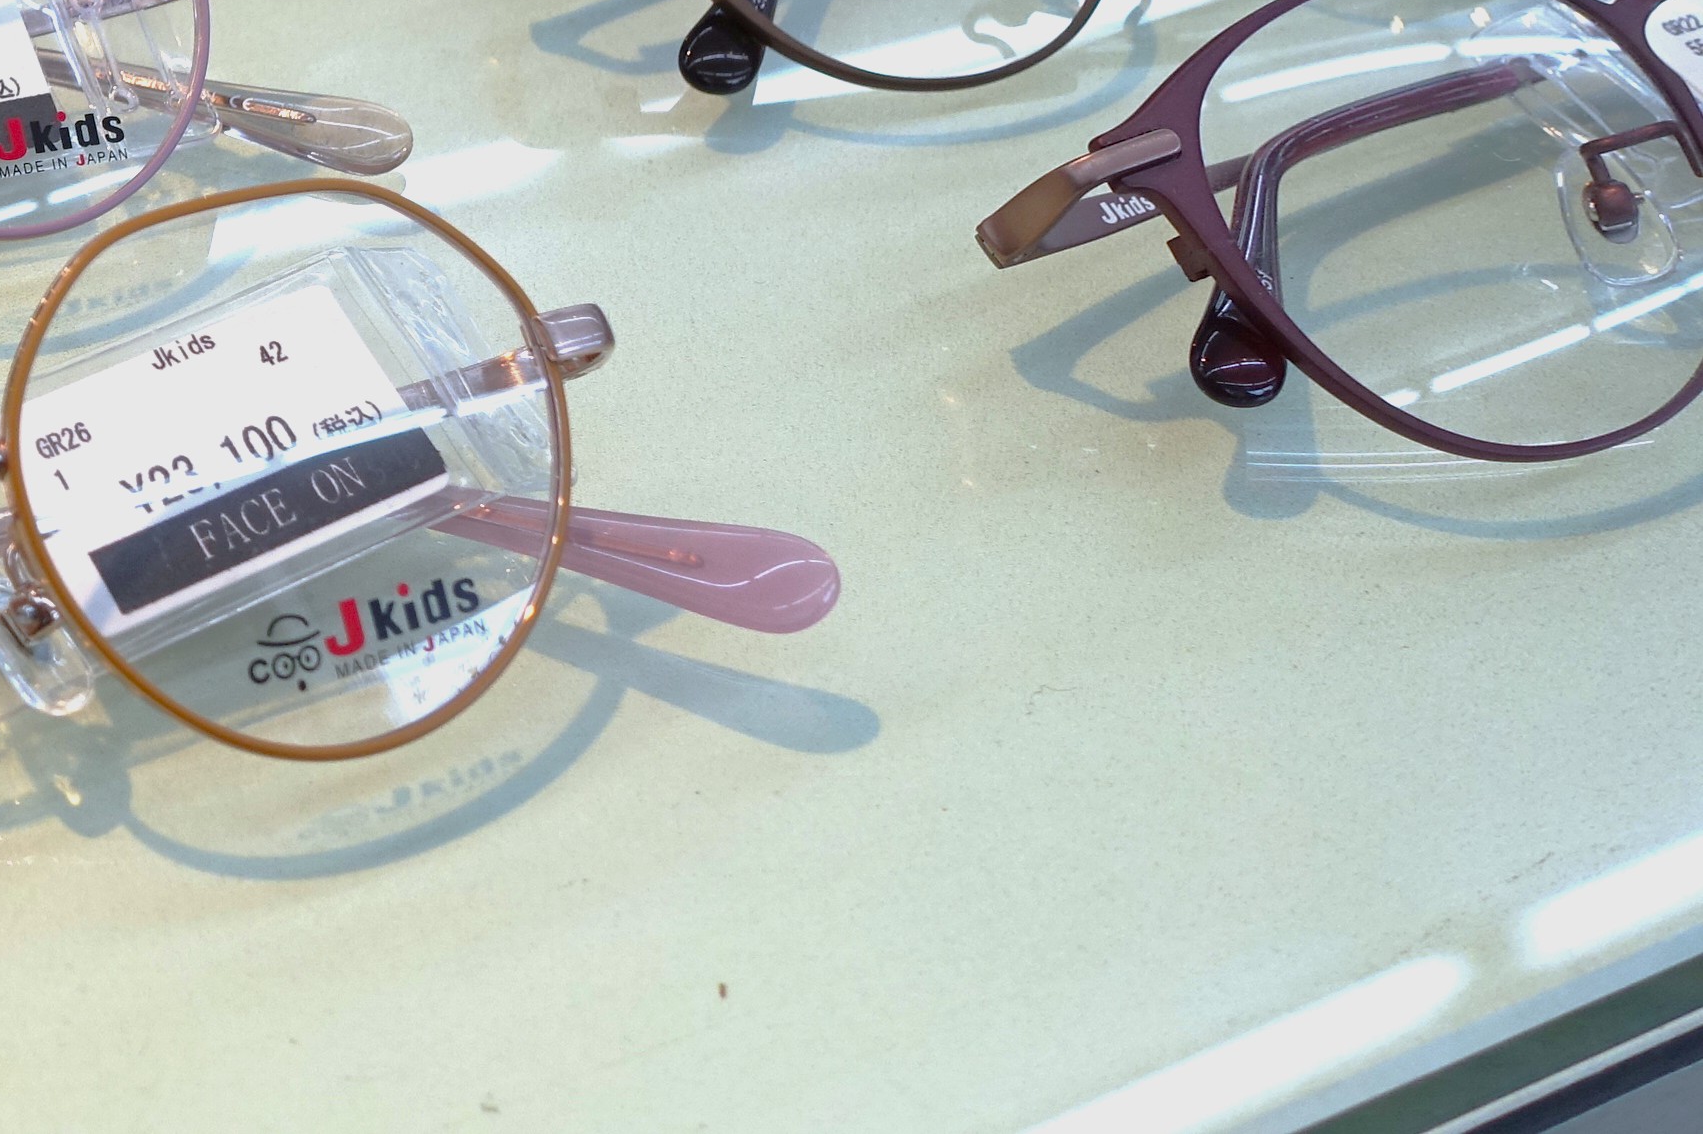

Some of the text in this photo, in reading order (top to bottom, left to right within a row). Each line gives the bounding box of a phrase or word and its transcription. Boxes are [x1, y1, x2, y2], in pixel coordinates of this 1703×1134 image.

[0, 148, 129, 179] MADE IN JAPAN
[1099, 195, 1157, 224] Jkids
[152, 334, 289, 371] Jkids 42
[35, 421, 93, 460] GR26
[53, 468, 70, 491] 1
[186, 456, 367, 561] FACE ON
[324, 577, 480, 656] Jkids
[335, 618, 489, 679] MADE IN JAPAN
